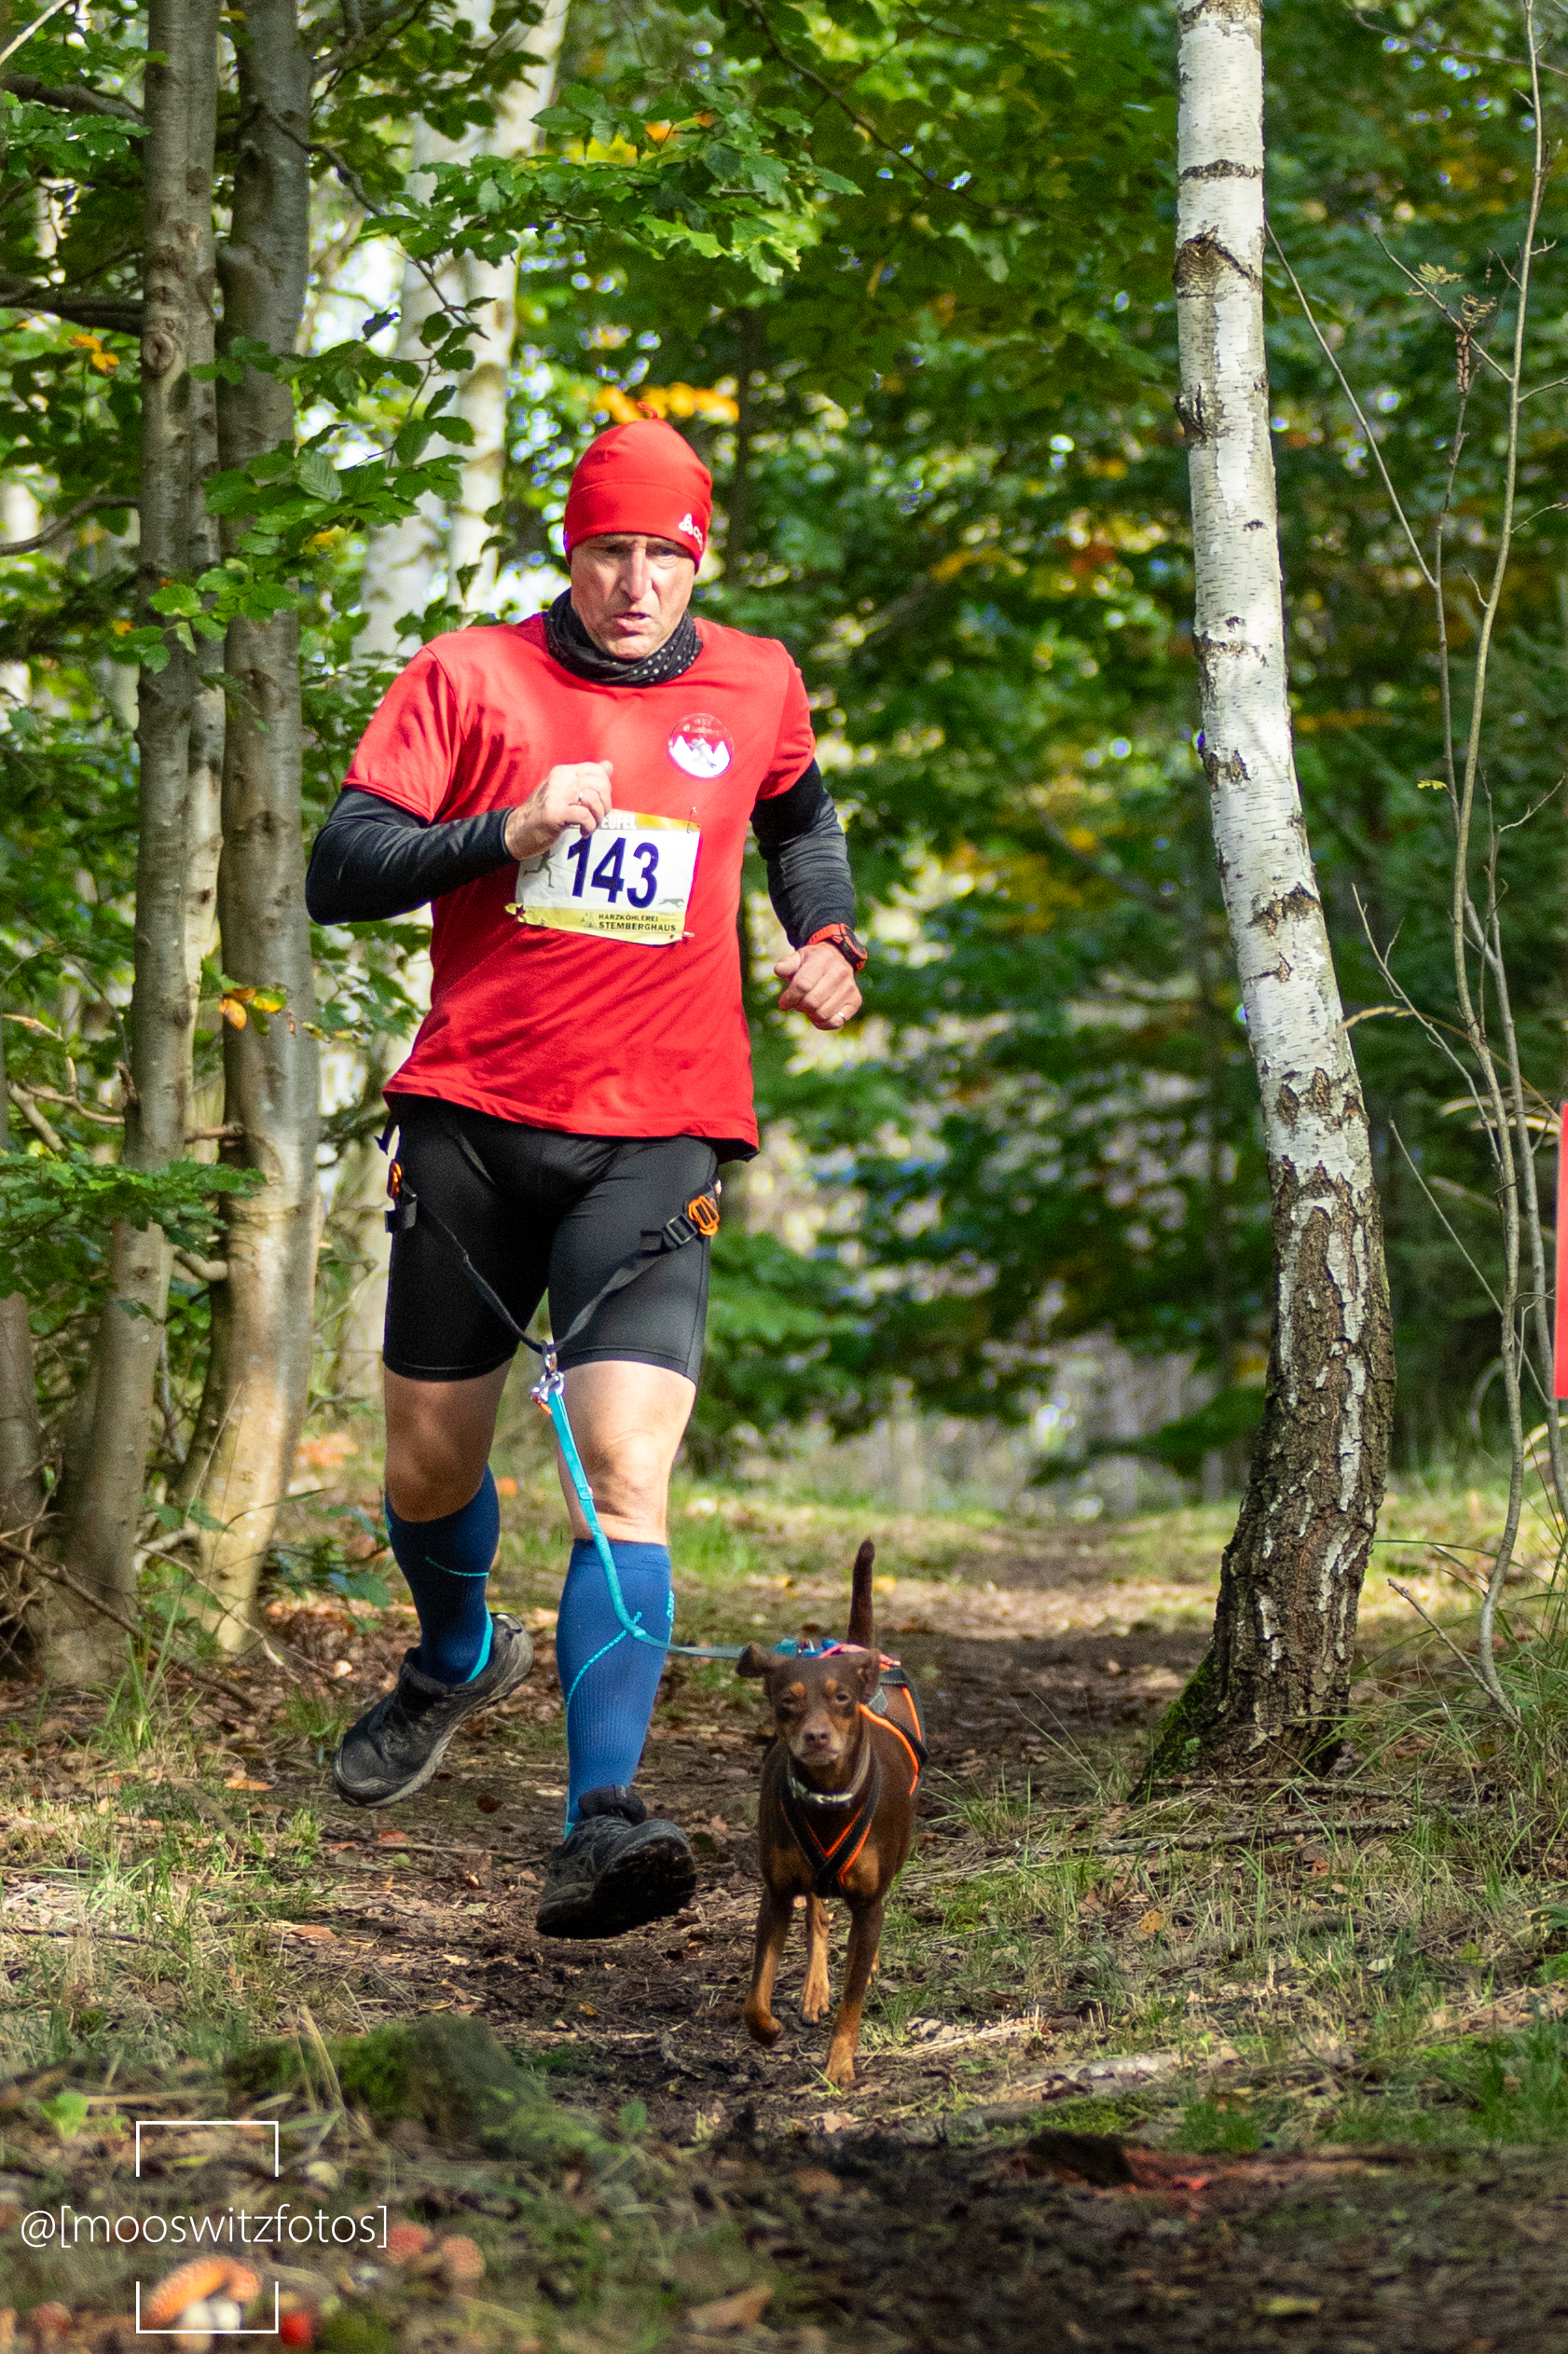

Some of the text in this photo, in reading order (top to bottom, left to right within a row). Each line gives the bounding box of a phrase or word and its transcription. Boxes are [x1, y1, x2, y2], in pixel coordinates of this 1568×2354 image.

[600, 812, 638, 830] EUFEL
[567, 833, 659, 909] 143
[598, 921, 677, 931] STEMBERGHAUS
